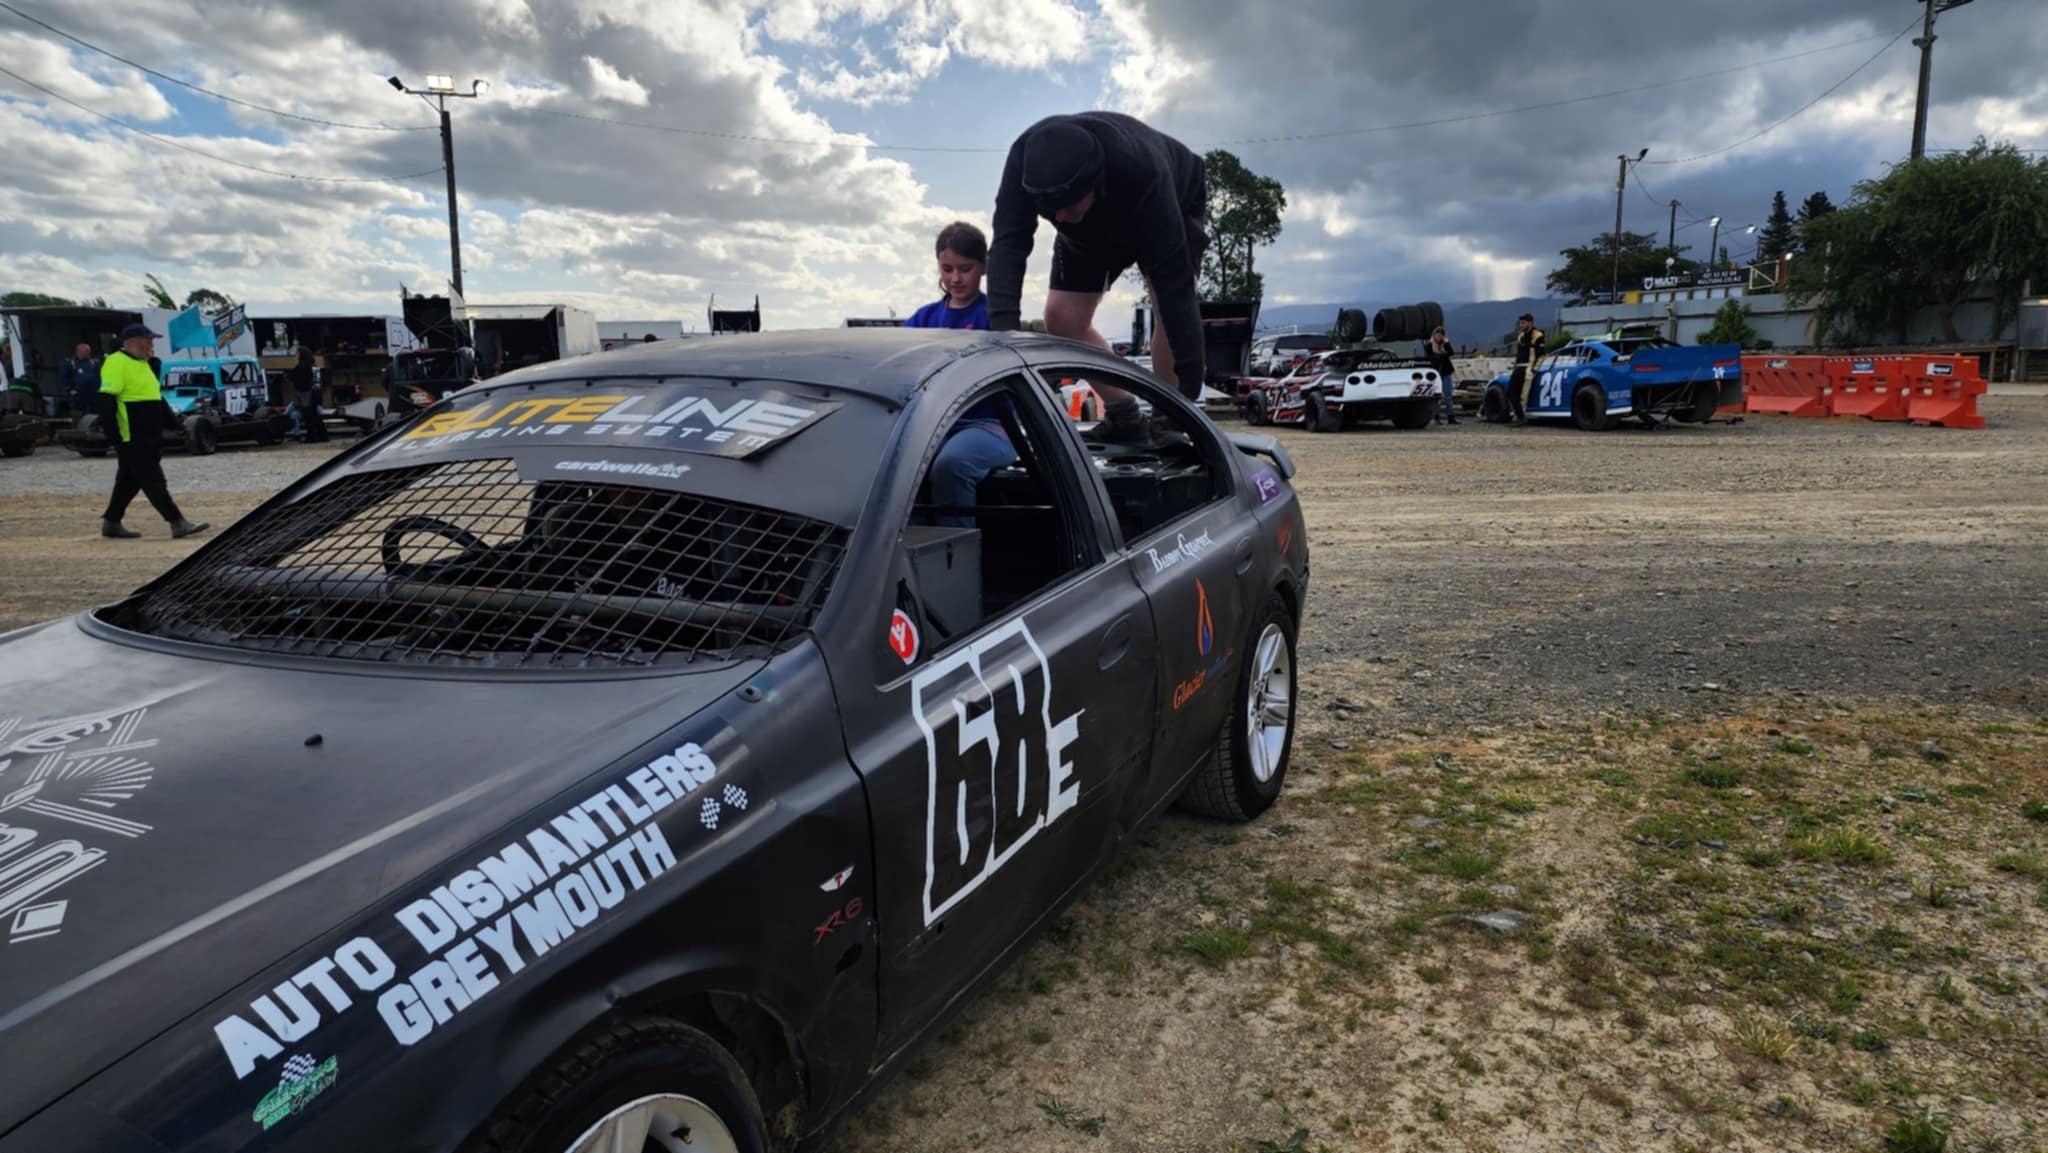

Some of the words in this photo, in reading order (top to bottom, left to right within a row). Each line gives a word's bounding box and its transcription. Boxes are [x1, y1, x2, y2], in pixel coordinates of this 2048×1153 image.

[400, 395, 817, 440] BUTELINE
[555, 460, 660, 476] cardwells
[213, 936, 396, 1080] AUTO
[394, 741, 717, 954] DISMANTLERS
[376, 821, 678, 1046] GREYMOUTH
